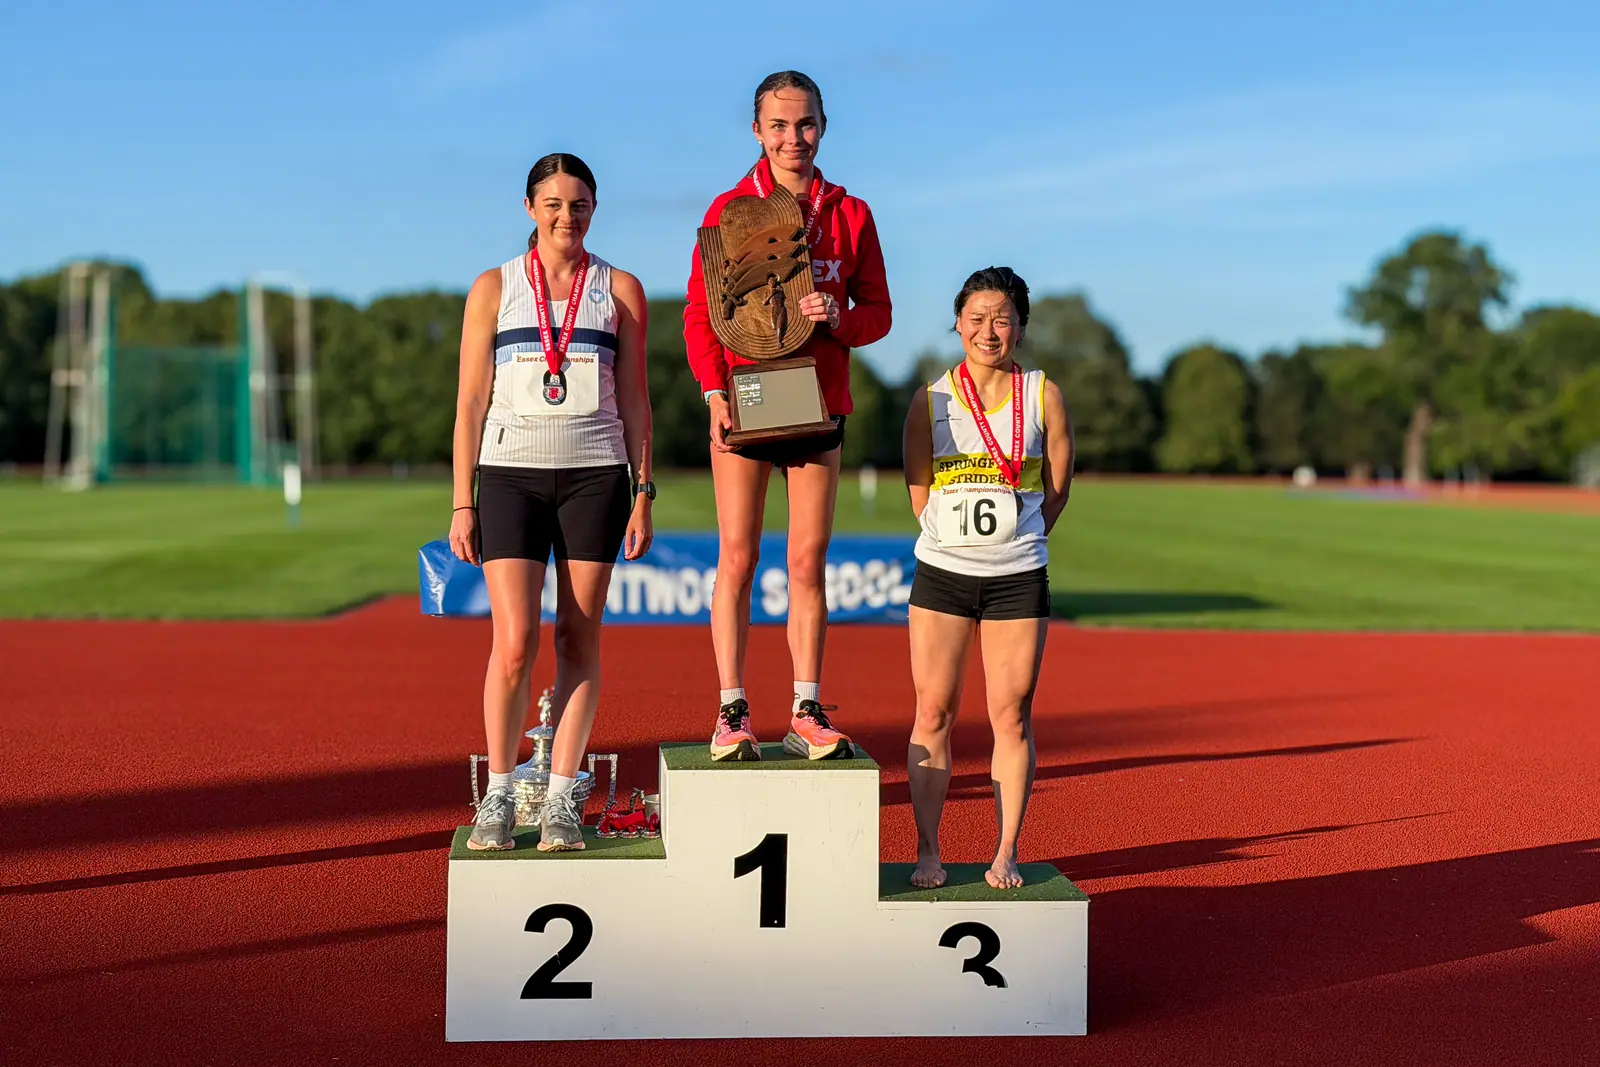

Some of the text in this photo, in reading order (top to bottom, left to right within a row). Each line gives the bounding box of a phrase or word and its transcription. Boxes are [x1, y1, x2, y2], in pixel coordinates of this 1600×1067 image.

[538, 304, 547, 330] COUNTY
[564, 306, 576, 331] COUNTY
[516, 355, 538, 364] Essex
[979, 420, 995, 446] COUNTY
[1013, 411, 1021, 438] COUNTY
[1012, 440, 1021, 462] ESSEX
[952, 498, 998, 537] 16
[733, 833, 789, 929] 1
[519, 903, 594, 1000] 2
[937, 920, 1009, 989] 3
